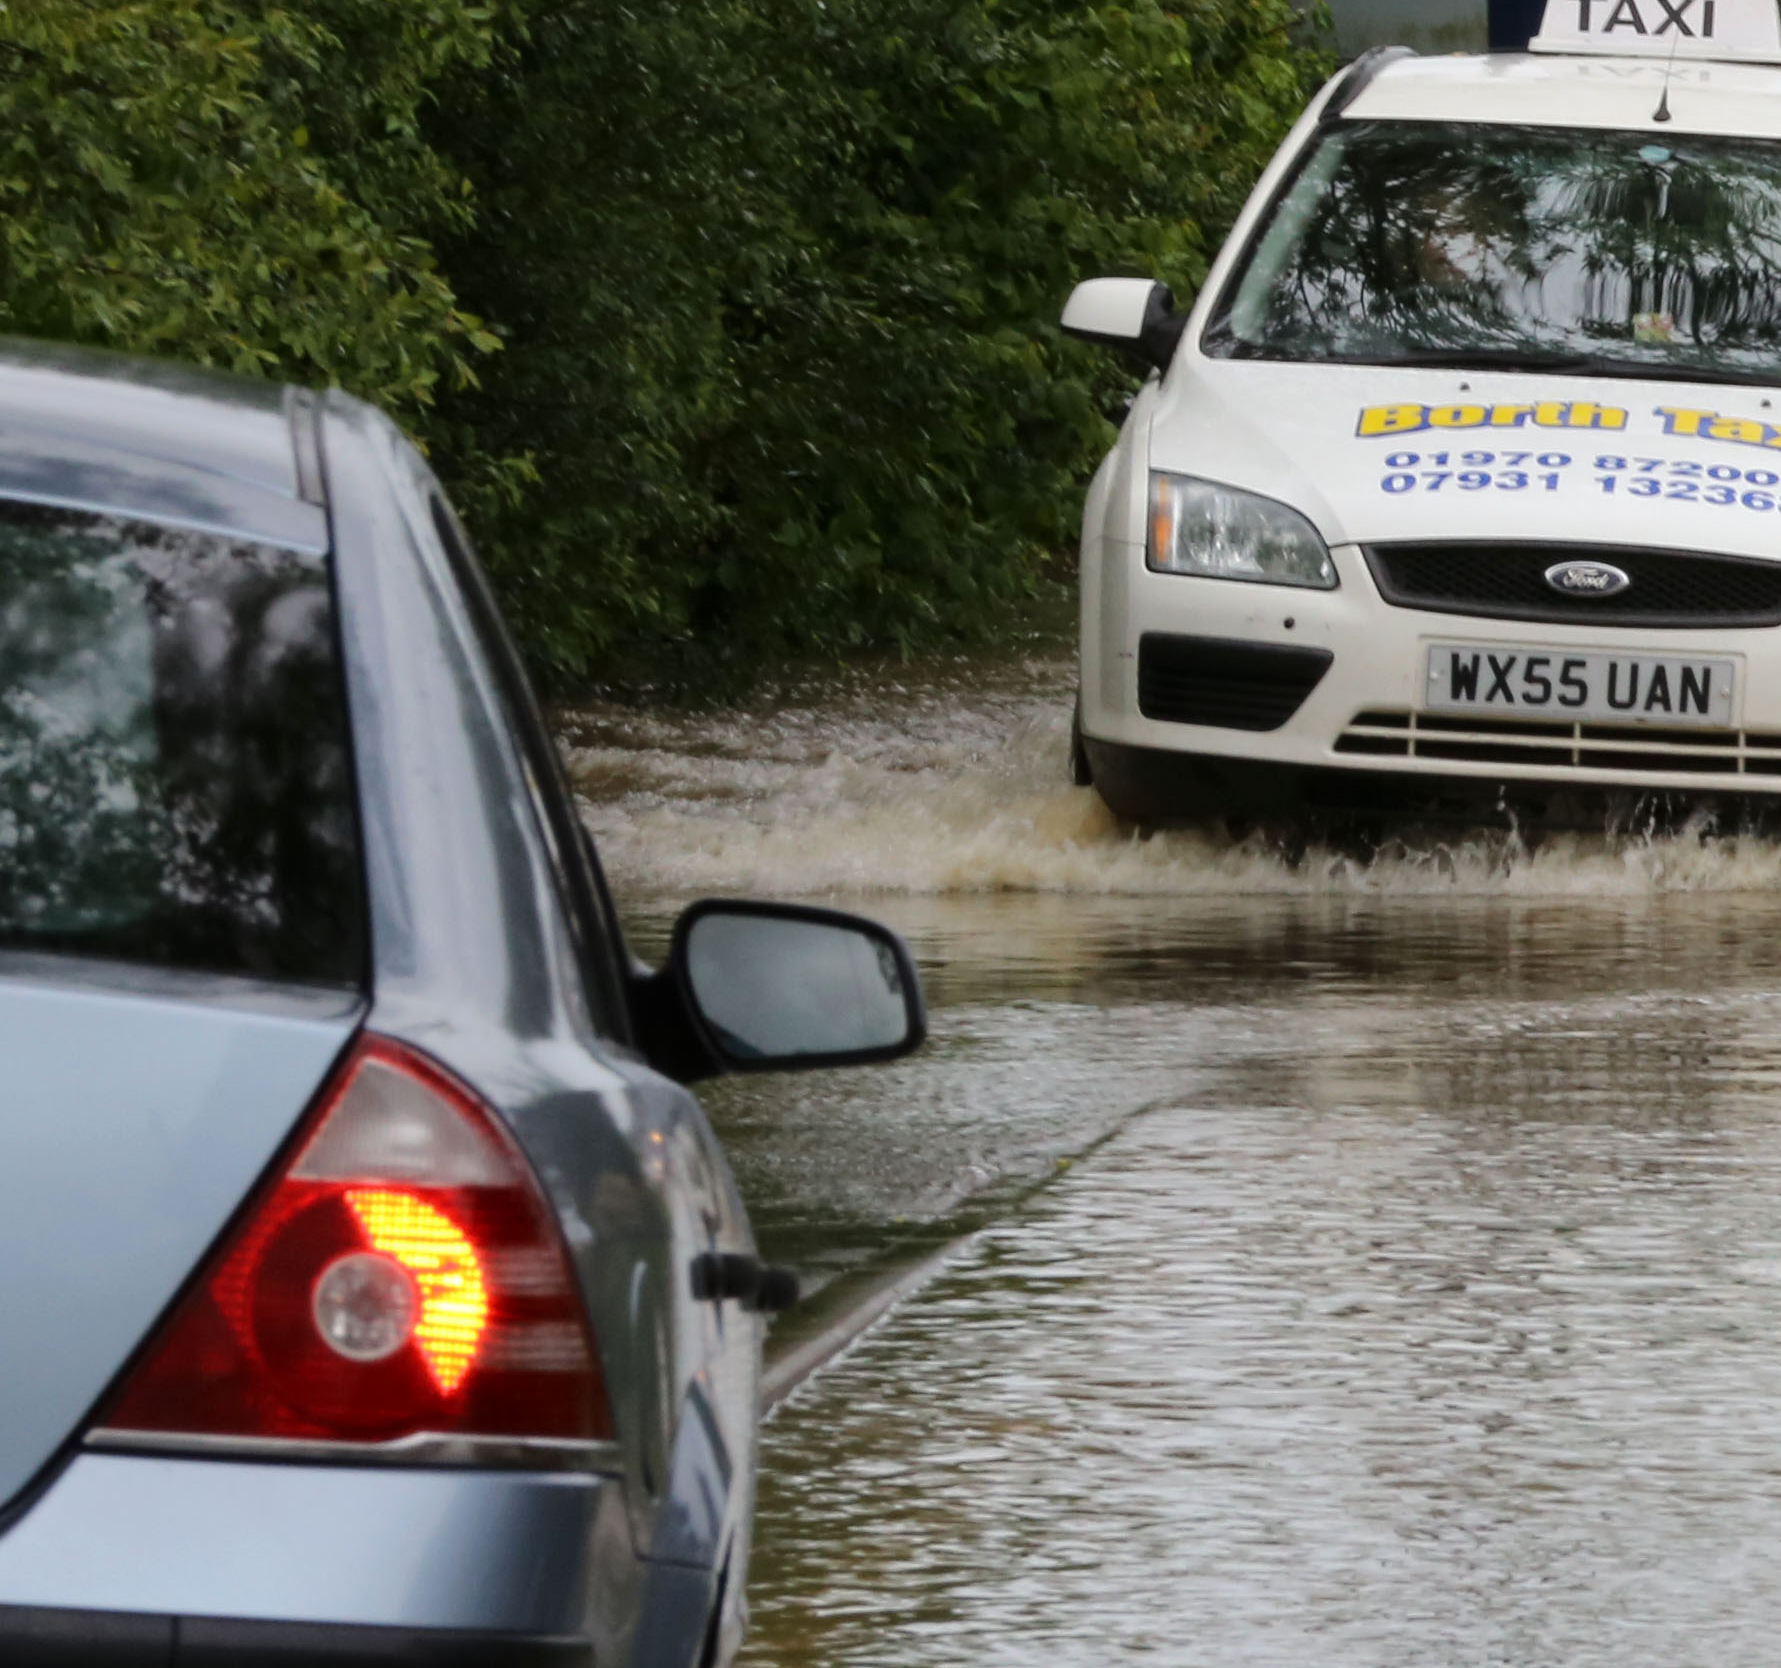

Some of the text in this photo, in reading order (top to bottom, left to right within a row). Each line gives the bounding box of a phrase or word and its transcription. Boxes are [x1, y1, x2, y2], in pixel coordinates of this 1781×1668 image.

[1355, 401, 1629, 438] Borth
[1384, 450, 1573, 468] 01970
[1380, 470, 1560, 494] 07931
[1563, 568, 1611, 590] Ford
[1450, 651, 1712, 715] WX55 UAN
